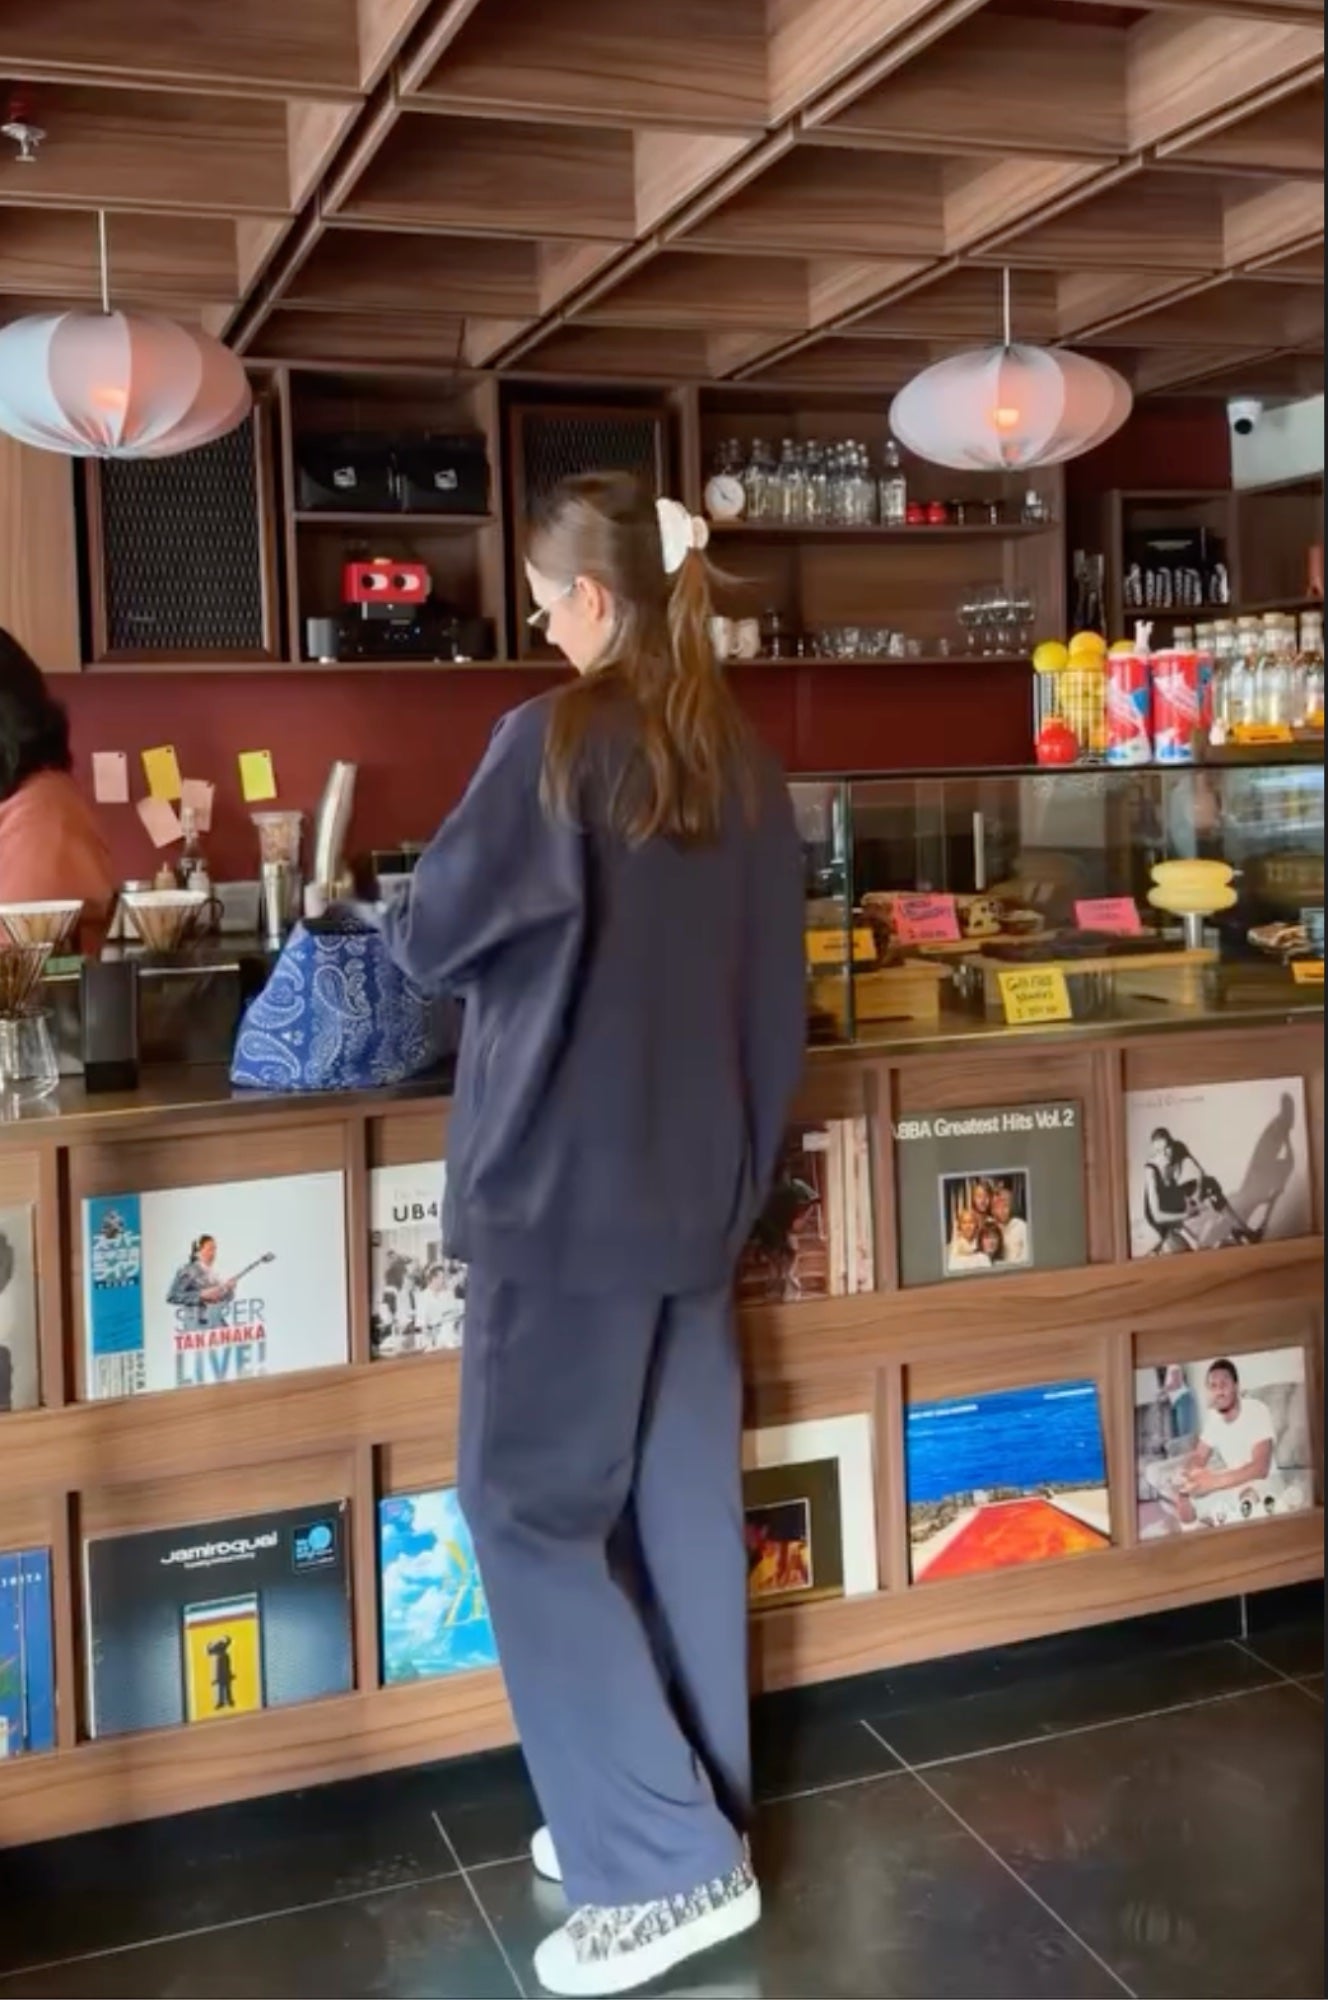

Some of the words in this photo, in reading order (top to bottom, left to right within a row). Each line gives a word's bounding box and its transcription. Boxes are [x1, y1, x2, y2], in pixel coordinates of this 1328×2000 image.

[934, 1116, 999, 1137] Greatest
[1002, 1112, 1034, 1131] Hits
[1063, 1108, 1075, 1127] 2
[174, 1324, 266, 1351] TAKANAKA
[160, 1530, 278, 1565] Jamiroquai
